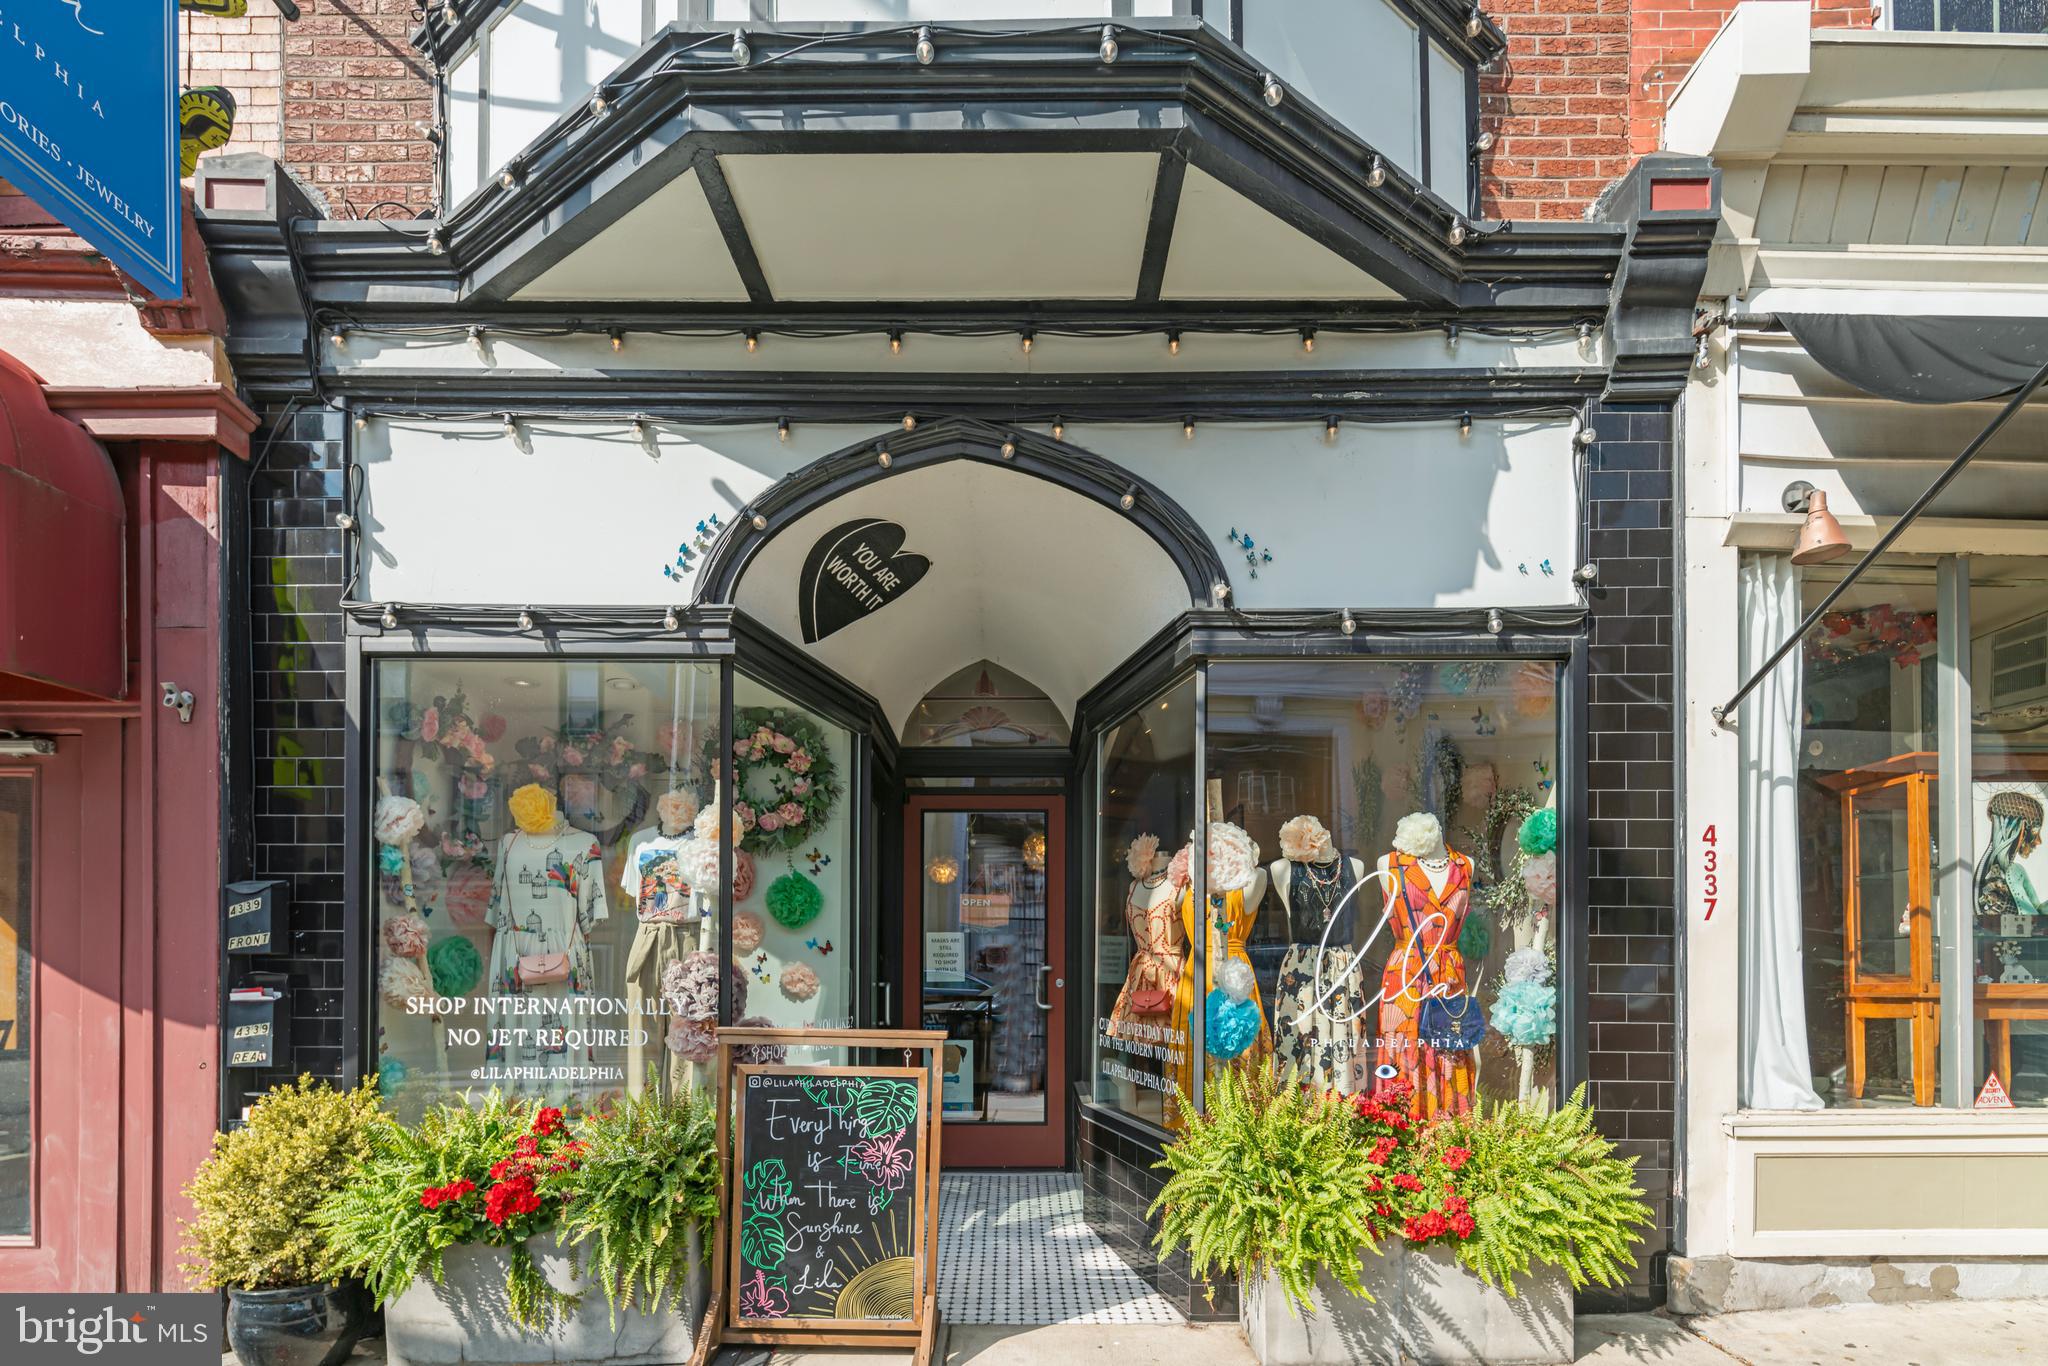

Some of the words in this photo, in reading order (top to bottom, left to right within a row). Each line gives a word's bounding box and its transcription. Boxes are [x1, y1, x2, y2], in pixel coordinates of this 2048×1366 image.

[0, 9, 104, 119] LPHIA
[76, 165, 155, 240] JEWELRY
[852, 542, 882, 570] YOU
[872, 567, 900, 592] ARE
[826, 555, 872, 601] WORTH
[865, 594, 884, 610] IT
[1702, 824, 1718, 921] 4337
[230, 900, 261, 916] 4339
[962, 898, 991, 907] OPEN
[229, 933, 269, 949] FRONT
[406, 996, 467, 1016] SHOP
[236, 1023, 269, 1038] 4339
[448, 1028, 481, 1047] NO
[488, 1028, 528, 1048] JET
[536, 1028, 649, 1050] REQUIRED
[1126, 1022, 1162, 1041] EVERYDAY
[1163, 1028, 1185, 1045] WEAR
[761, 1045, 785, 1060] SHOP
[1099, 1034, 1111, 1048] FOR
[1112, 1038, 1124, 1051] THE
[1125, 1041, 1153, 1058] MODERN
[1154, 1046, 1185, 1065] WOMAN
[1310, 1038, 1466, 1049] PHILADELPHIA
[470, 1066, 624, 1081] @LILAPHILADELPHIA
[1978, 1096, 2006, 1104] ADVENT
[808, 1149, 832, 1172] is
[759, 1175, 805, 1211] When
[867, 1191, 882, 1216] is
[785, 1212, 863, 1252] Sunshine
[815, 1245, 825, 1259] &
[792, 1259, 844, 1295] Lila
